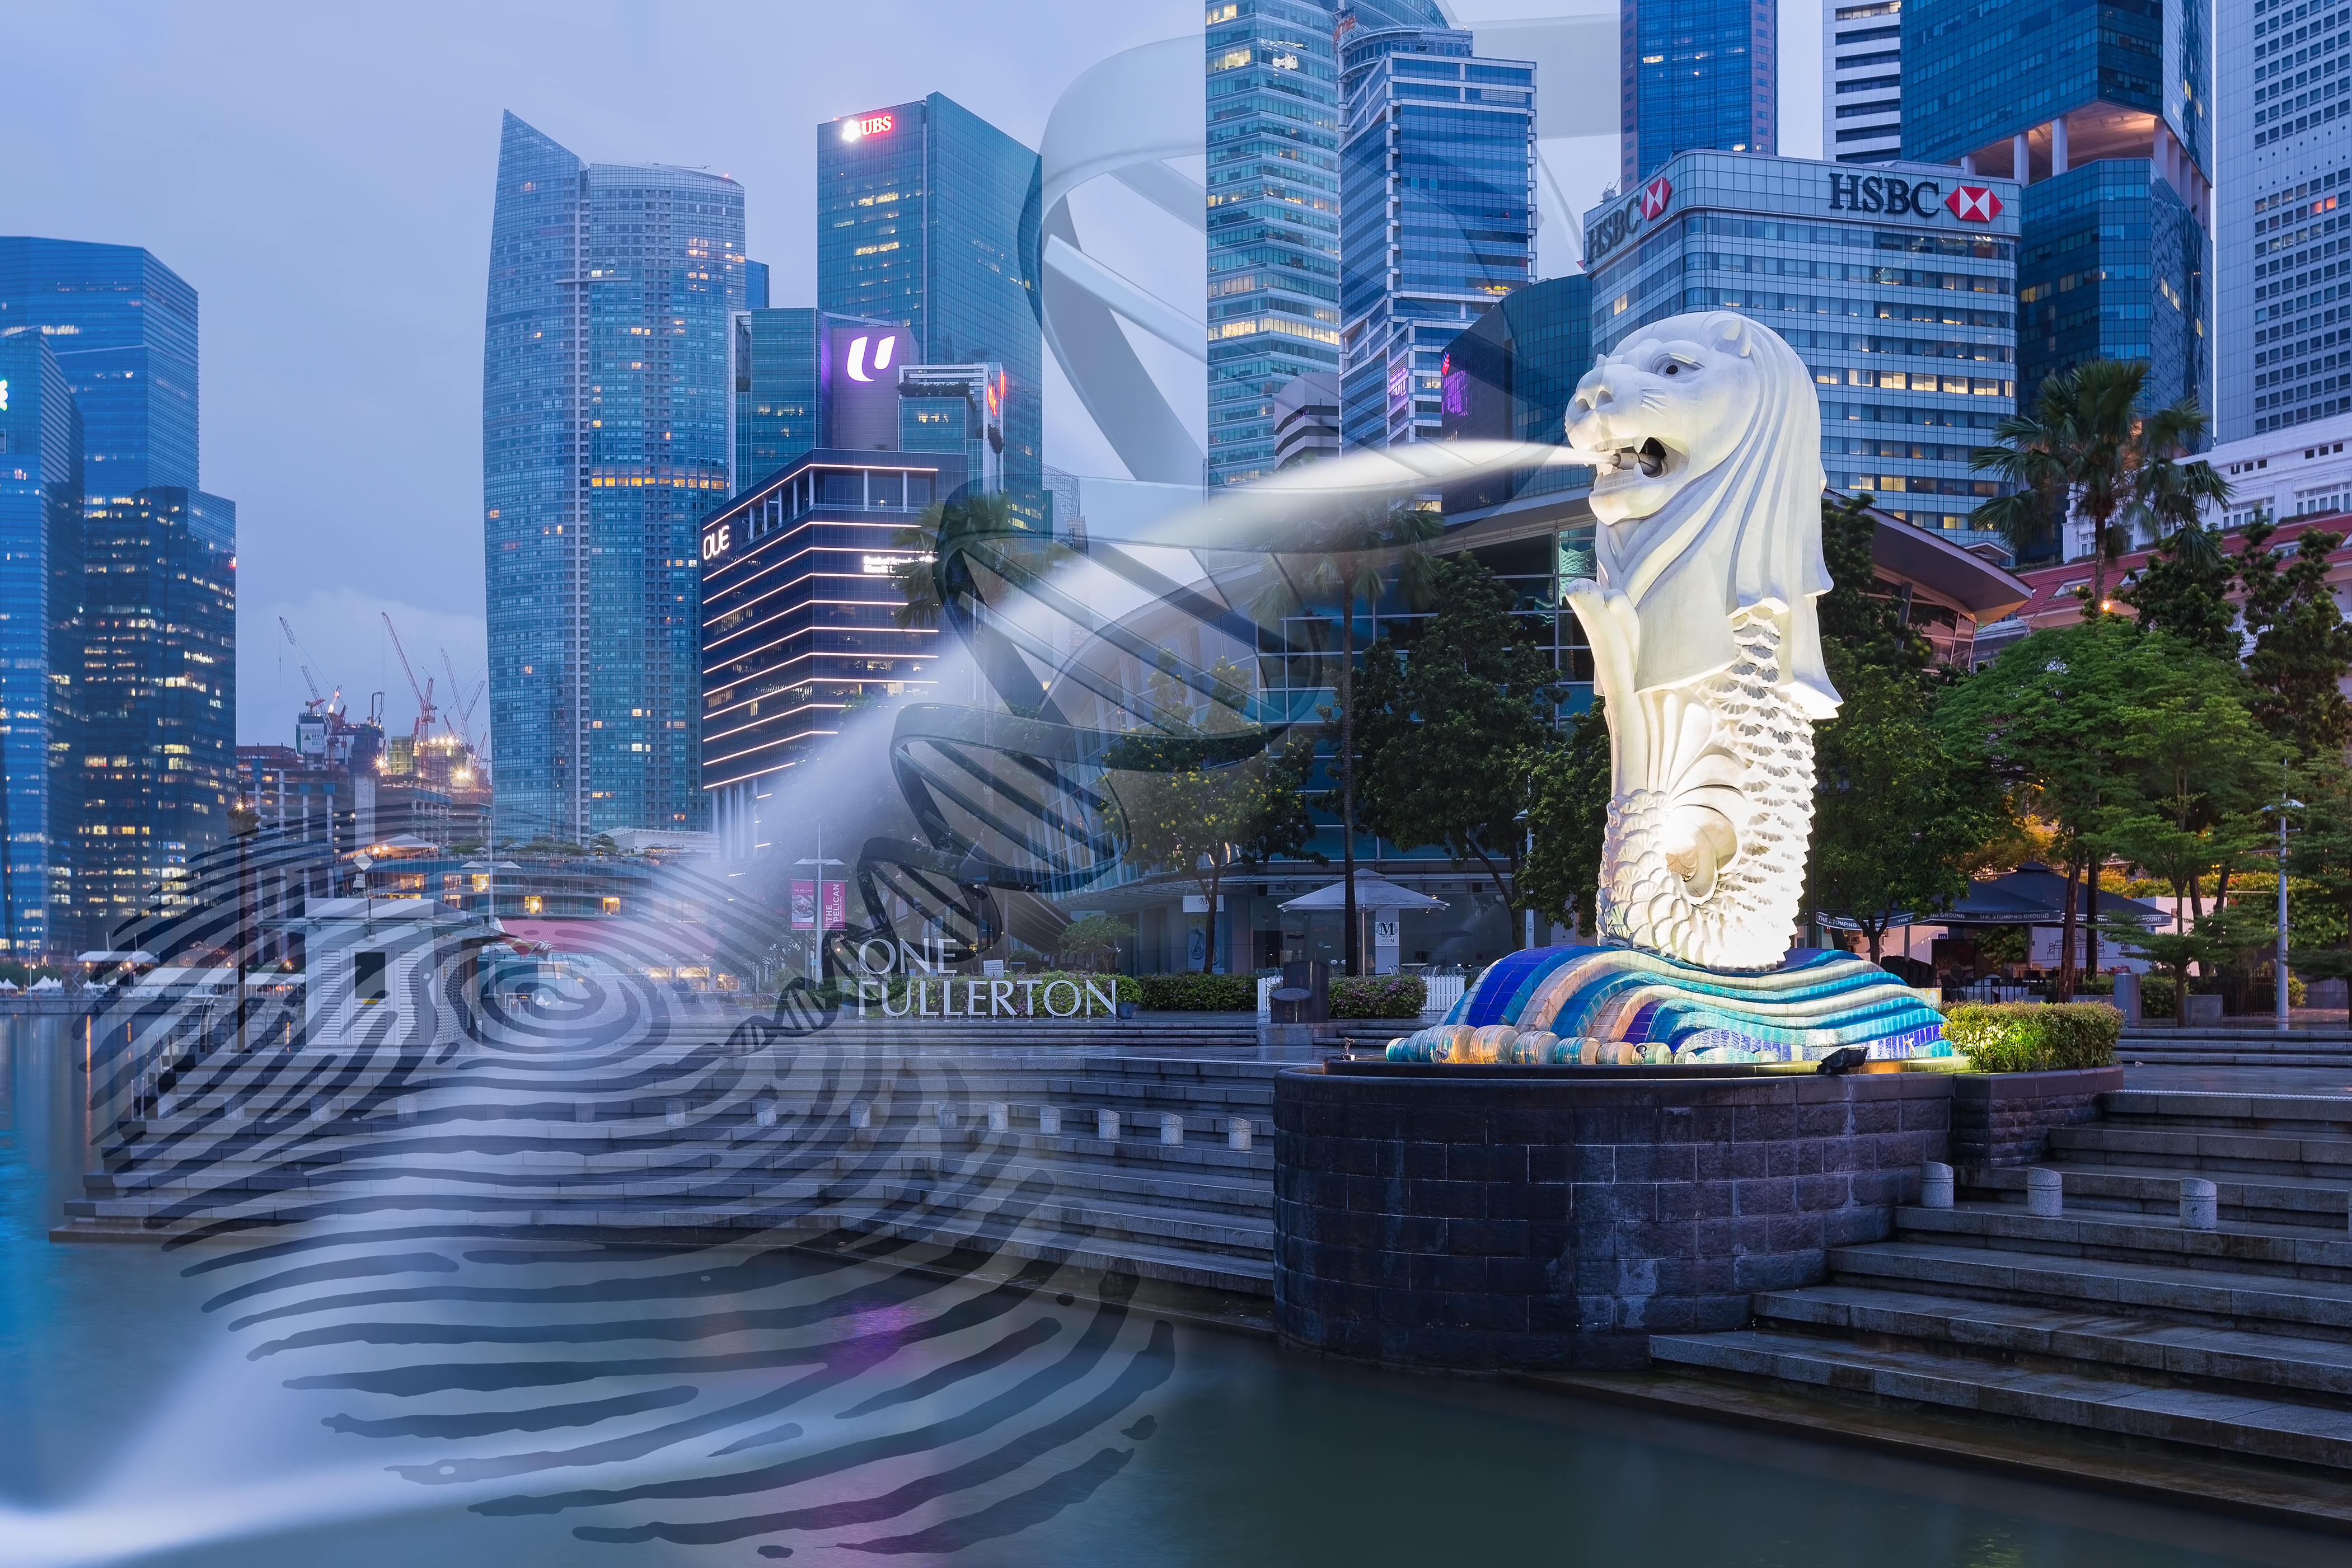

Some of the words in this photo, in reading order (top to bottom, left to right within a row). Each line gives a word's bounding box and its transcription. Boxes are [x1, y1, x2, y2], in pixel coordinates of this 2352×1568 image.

[861, 115, 892, 135] UBS
[1829, 172, 1941, 218] HSBC
[1586, 194, 1640, 264] HSBC
[703, 525, 730, 560] OUE
[567, 866, 584, 875] BAY
[585, 867, 613, 875] HOTEL
[859, 938, 957, 975] ONE
[858, 979, 1117, 1017] FULLERTON
